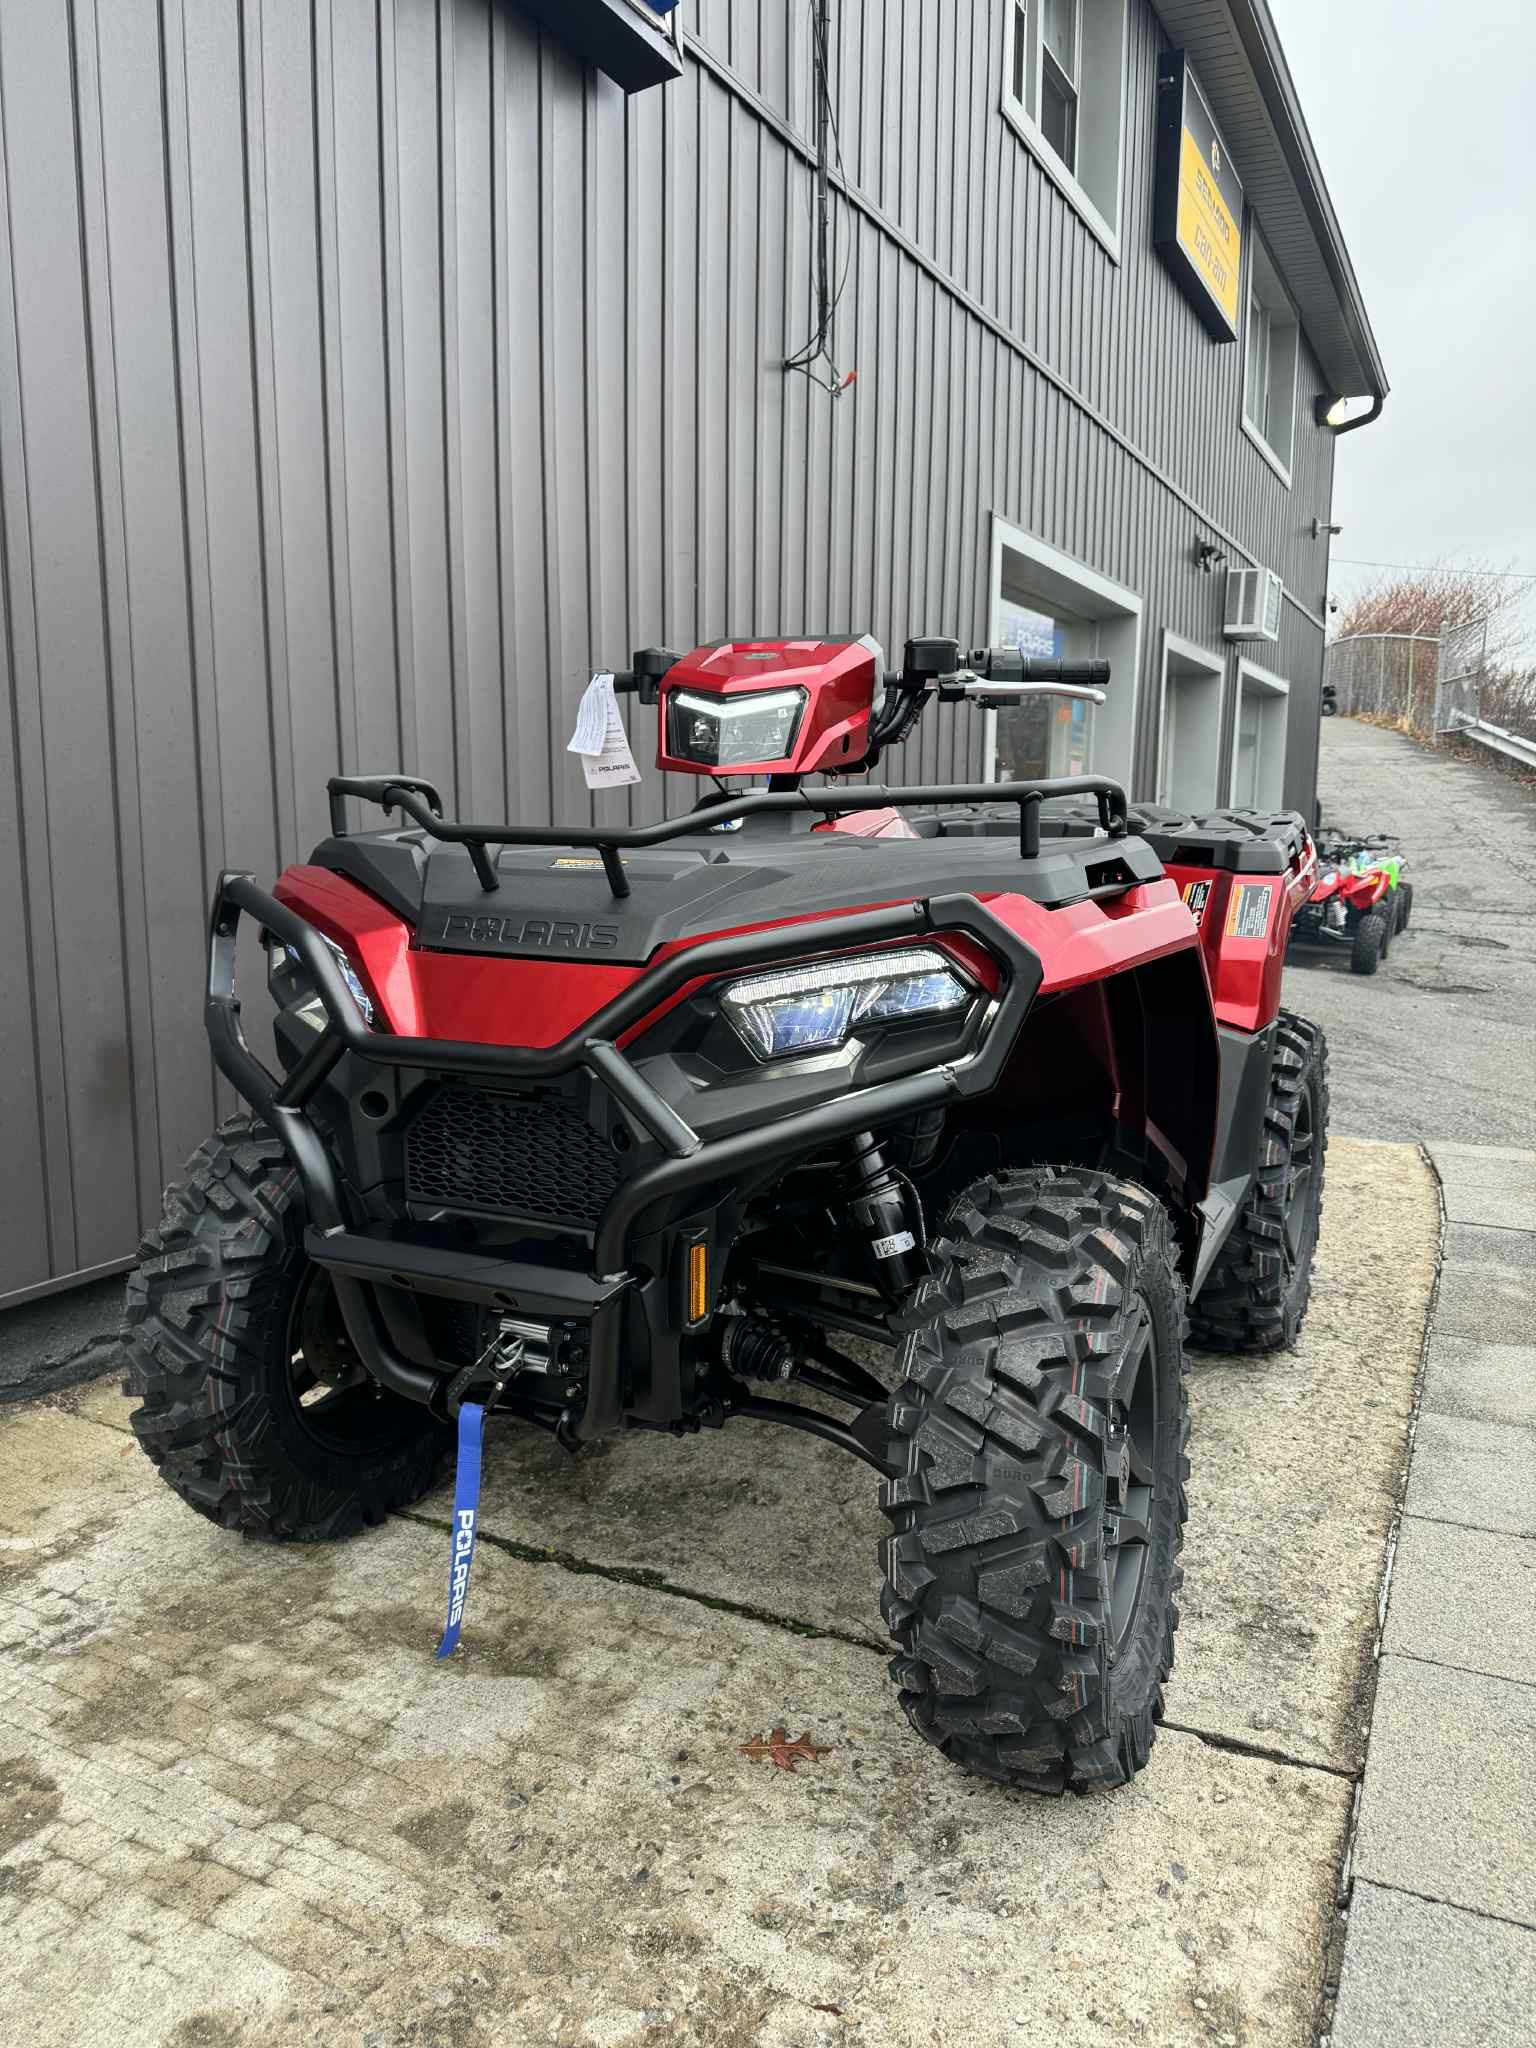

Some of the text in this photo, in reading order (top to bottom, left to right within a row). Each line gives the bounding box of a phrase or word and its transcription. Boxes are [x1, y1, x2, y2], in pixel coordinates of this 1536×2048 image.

[598, 763, 631, 773] POLARIS
[441, 914, 620, 951] POLARIS
[448, 1509, 475, 1628] POLARIS
